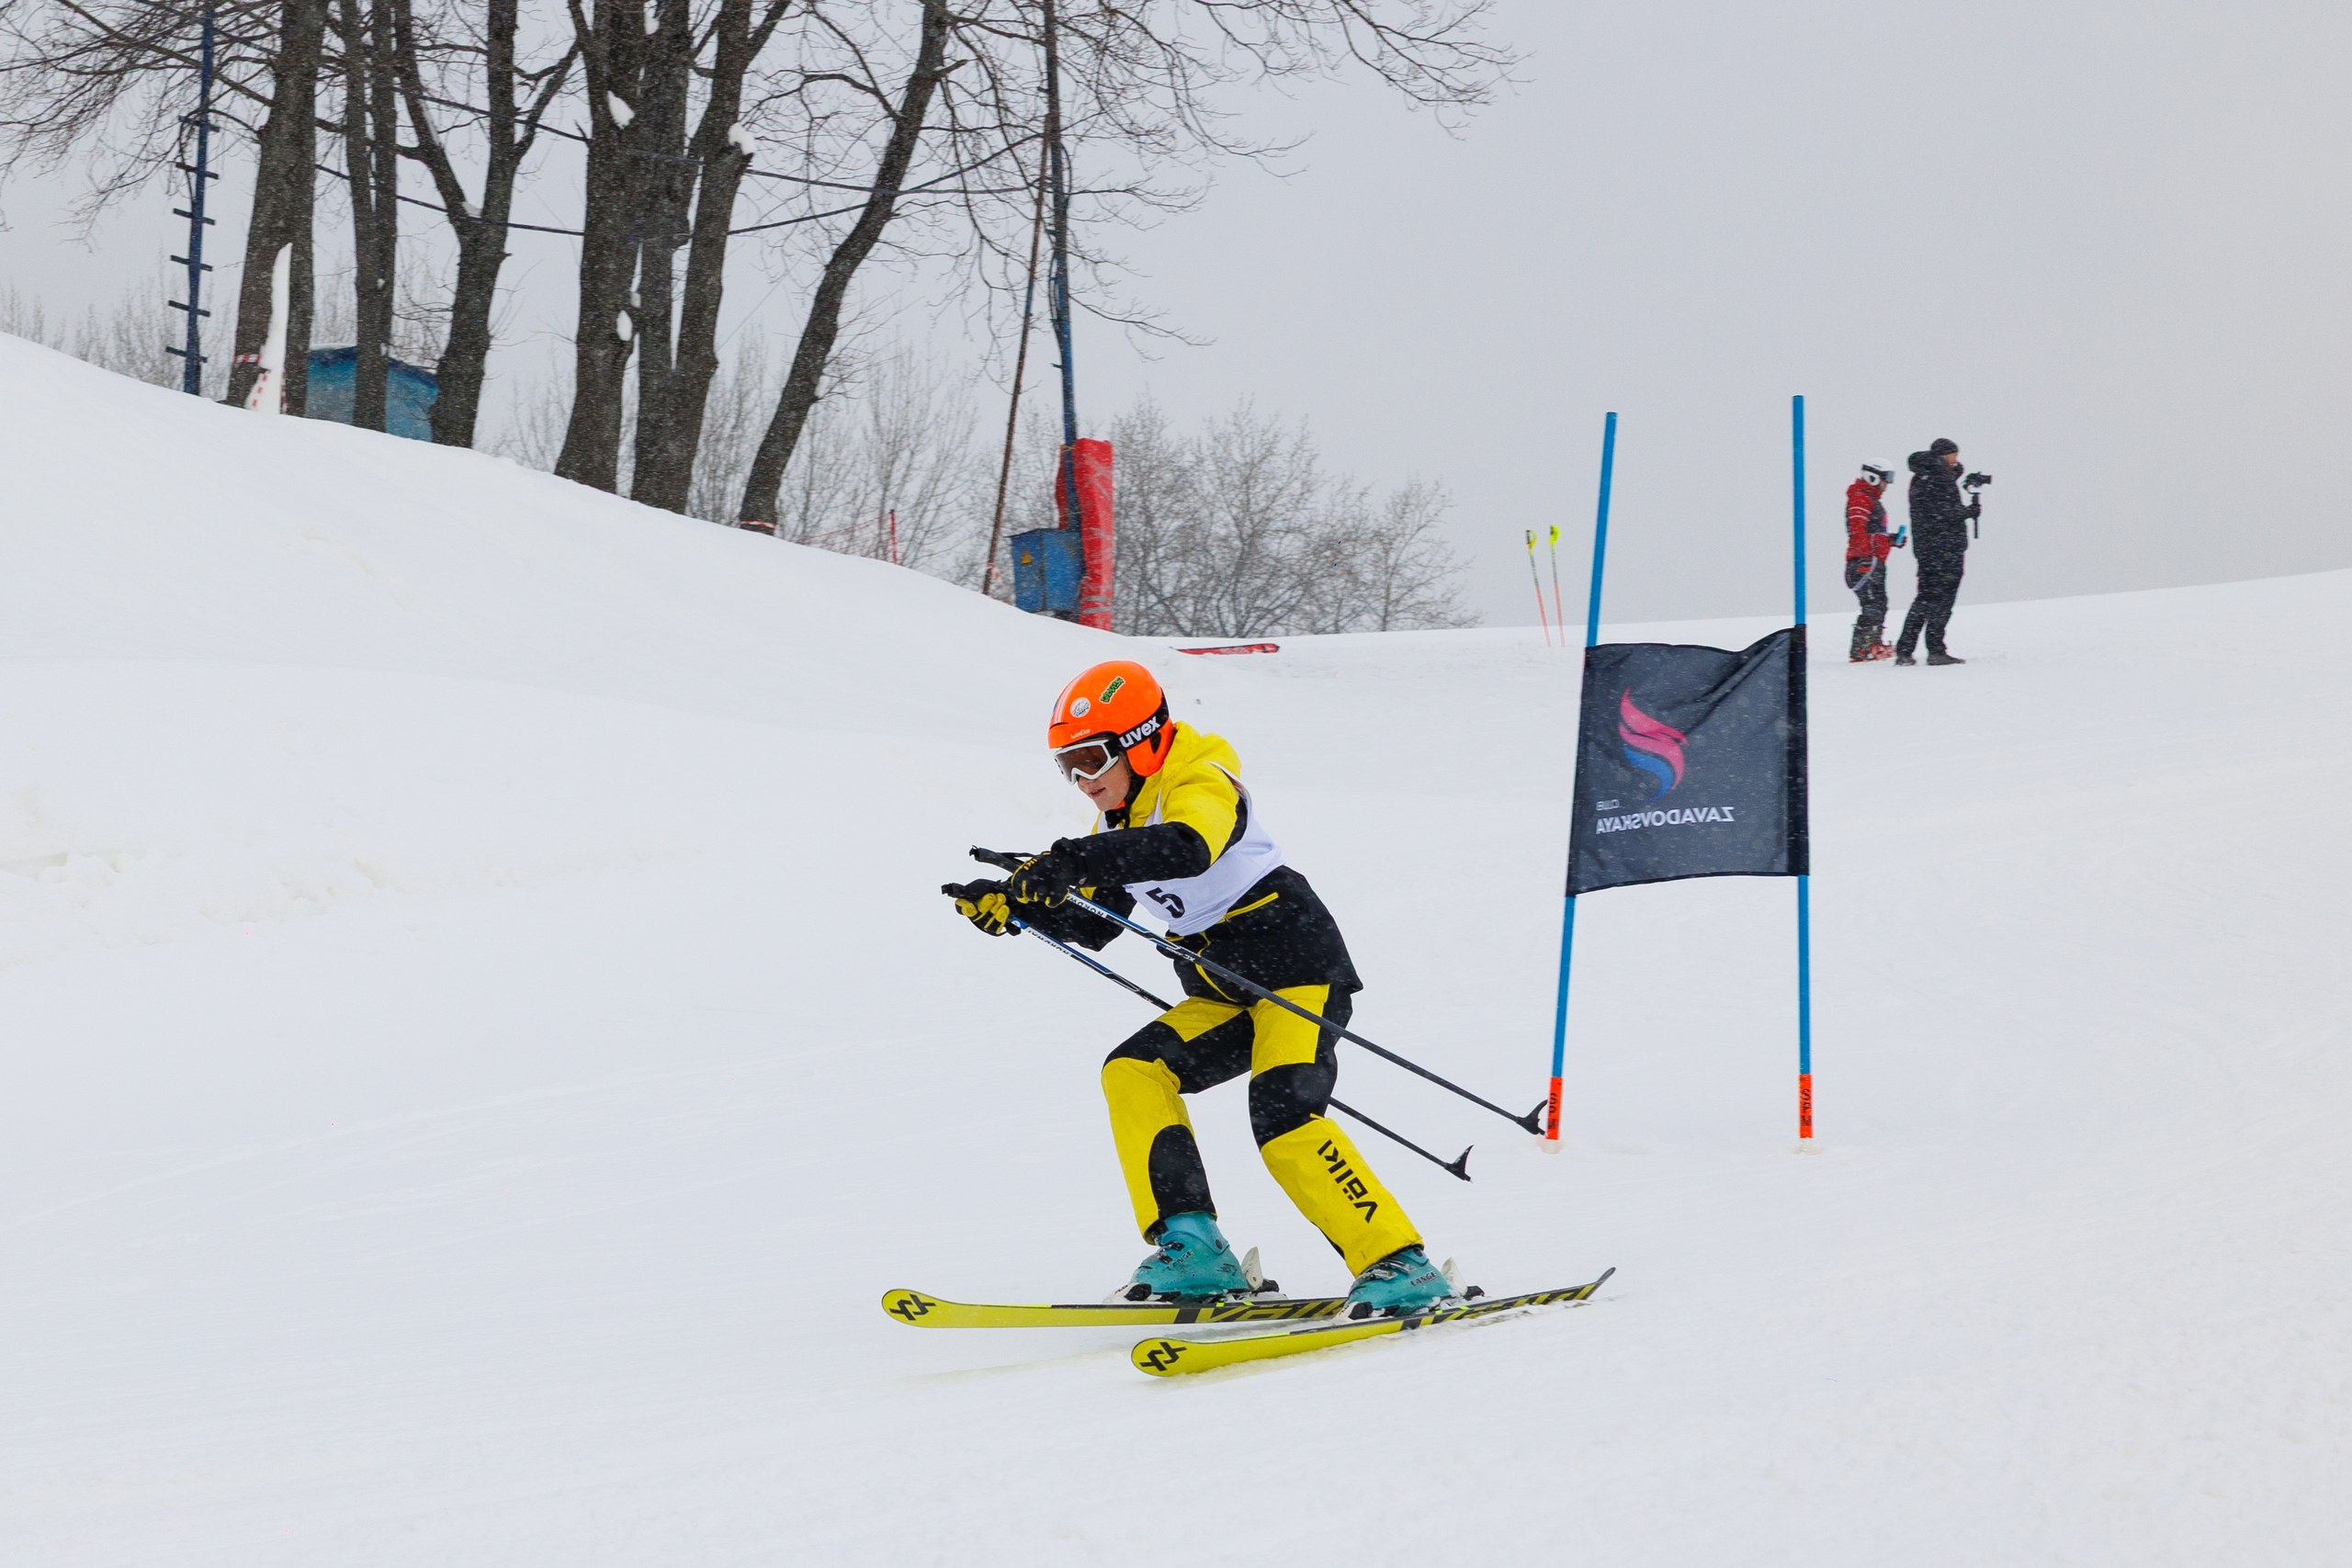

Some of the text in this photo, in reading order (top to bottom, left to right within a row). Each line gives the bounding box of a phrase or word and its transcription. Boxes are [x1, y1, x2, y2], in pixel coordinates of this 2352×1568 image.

[1119, 716, 1160, 748] uvex
[1145, 886, 1186, 919] 5
[1317, 1138, 1378, 1224] Völkl
[1409, 1270, 1437, 1287] LANGE
